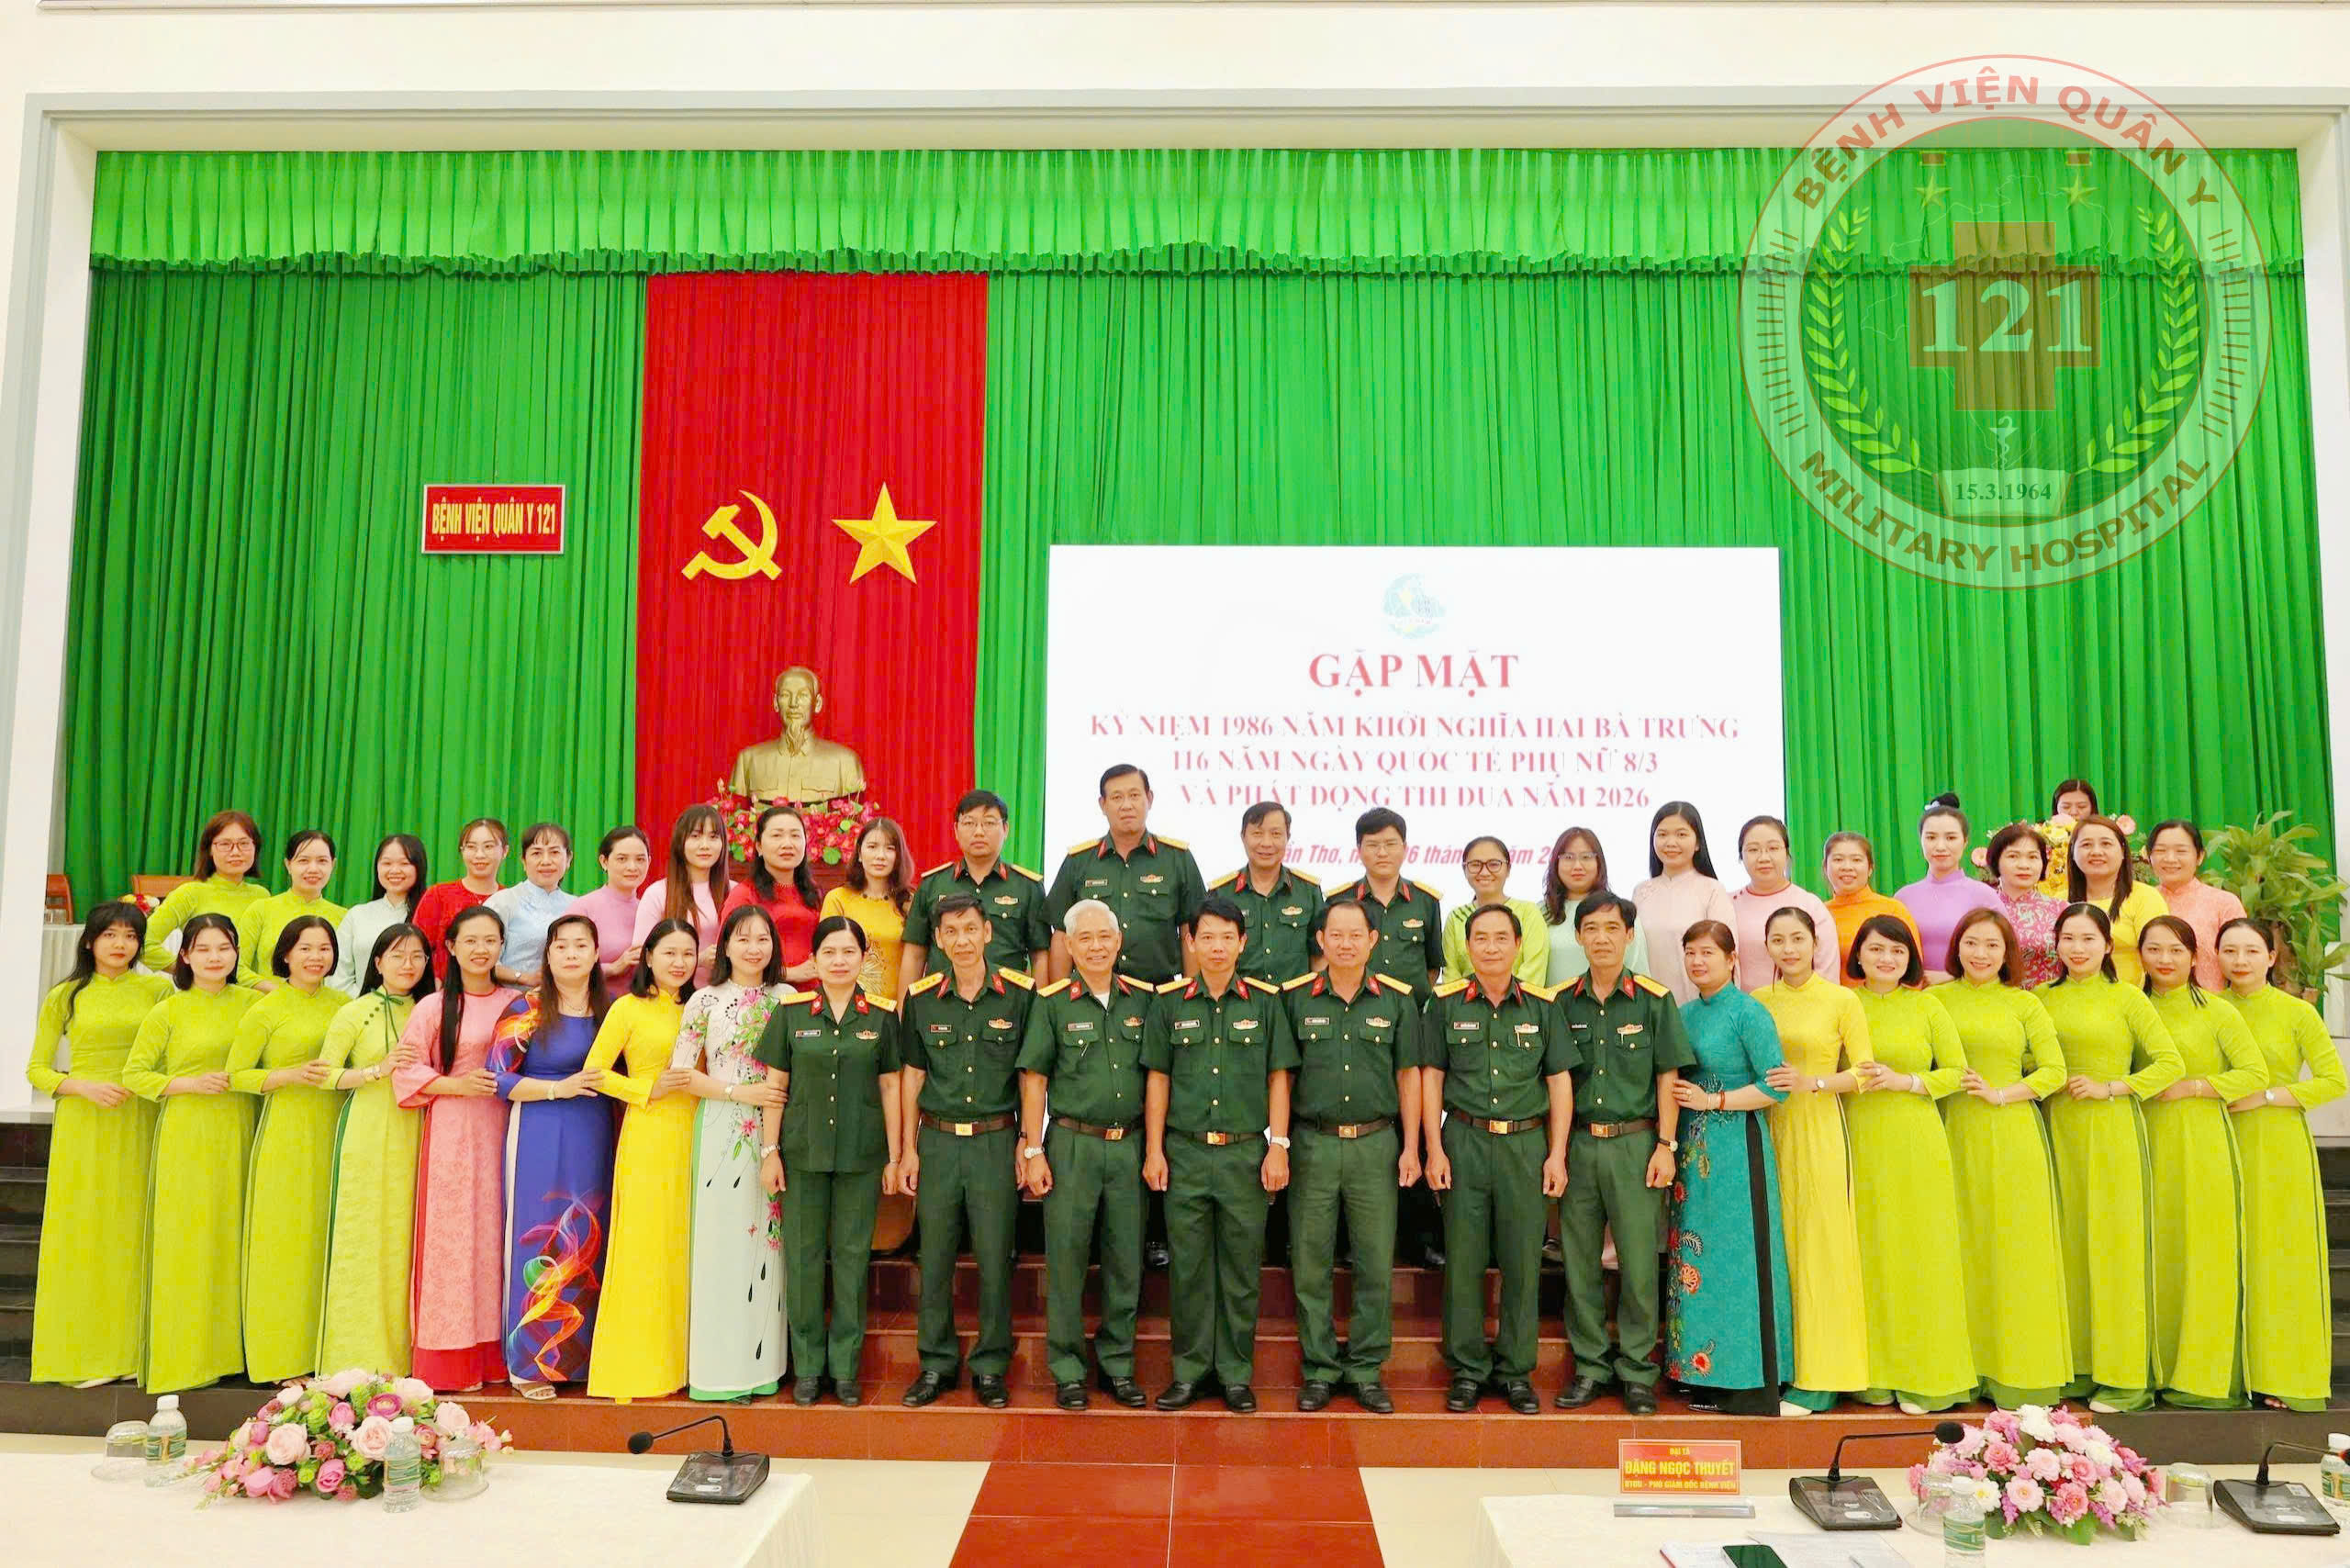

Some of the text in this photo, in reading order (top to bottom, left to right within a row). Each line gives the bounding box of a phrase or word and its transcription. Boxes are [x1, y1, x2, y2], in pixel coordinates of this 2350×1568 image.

[431, 497, 555, 542] BỆNH VIỆN QUÂN Y 121
[1309, 649, 1519, 697] GẶP MẶT
[1222, 715, 1273, 737] 1986
[1282, 711, 1345, 737] NĂM
[1536, 716, 1585, 738] HAI
[1173, 751, 1209, 770] 116
[1218, 745, 1280, 771] NĂM
[1624, 751, 1658, 774] 8/3
[1401, 786, 1447, 807] THI
[1522, 782, 1585, 808] NĂM
[1595, 787, 1650, 809] 2026
[1424, 845, 1463, 864] thán
[1660, 1462, 1691, 1477] NGỌC
